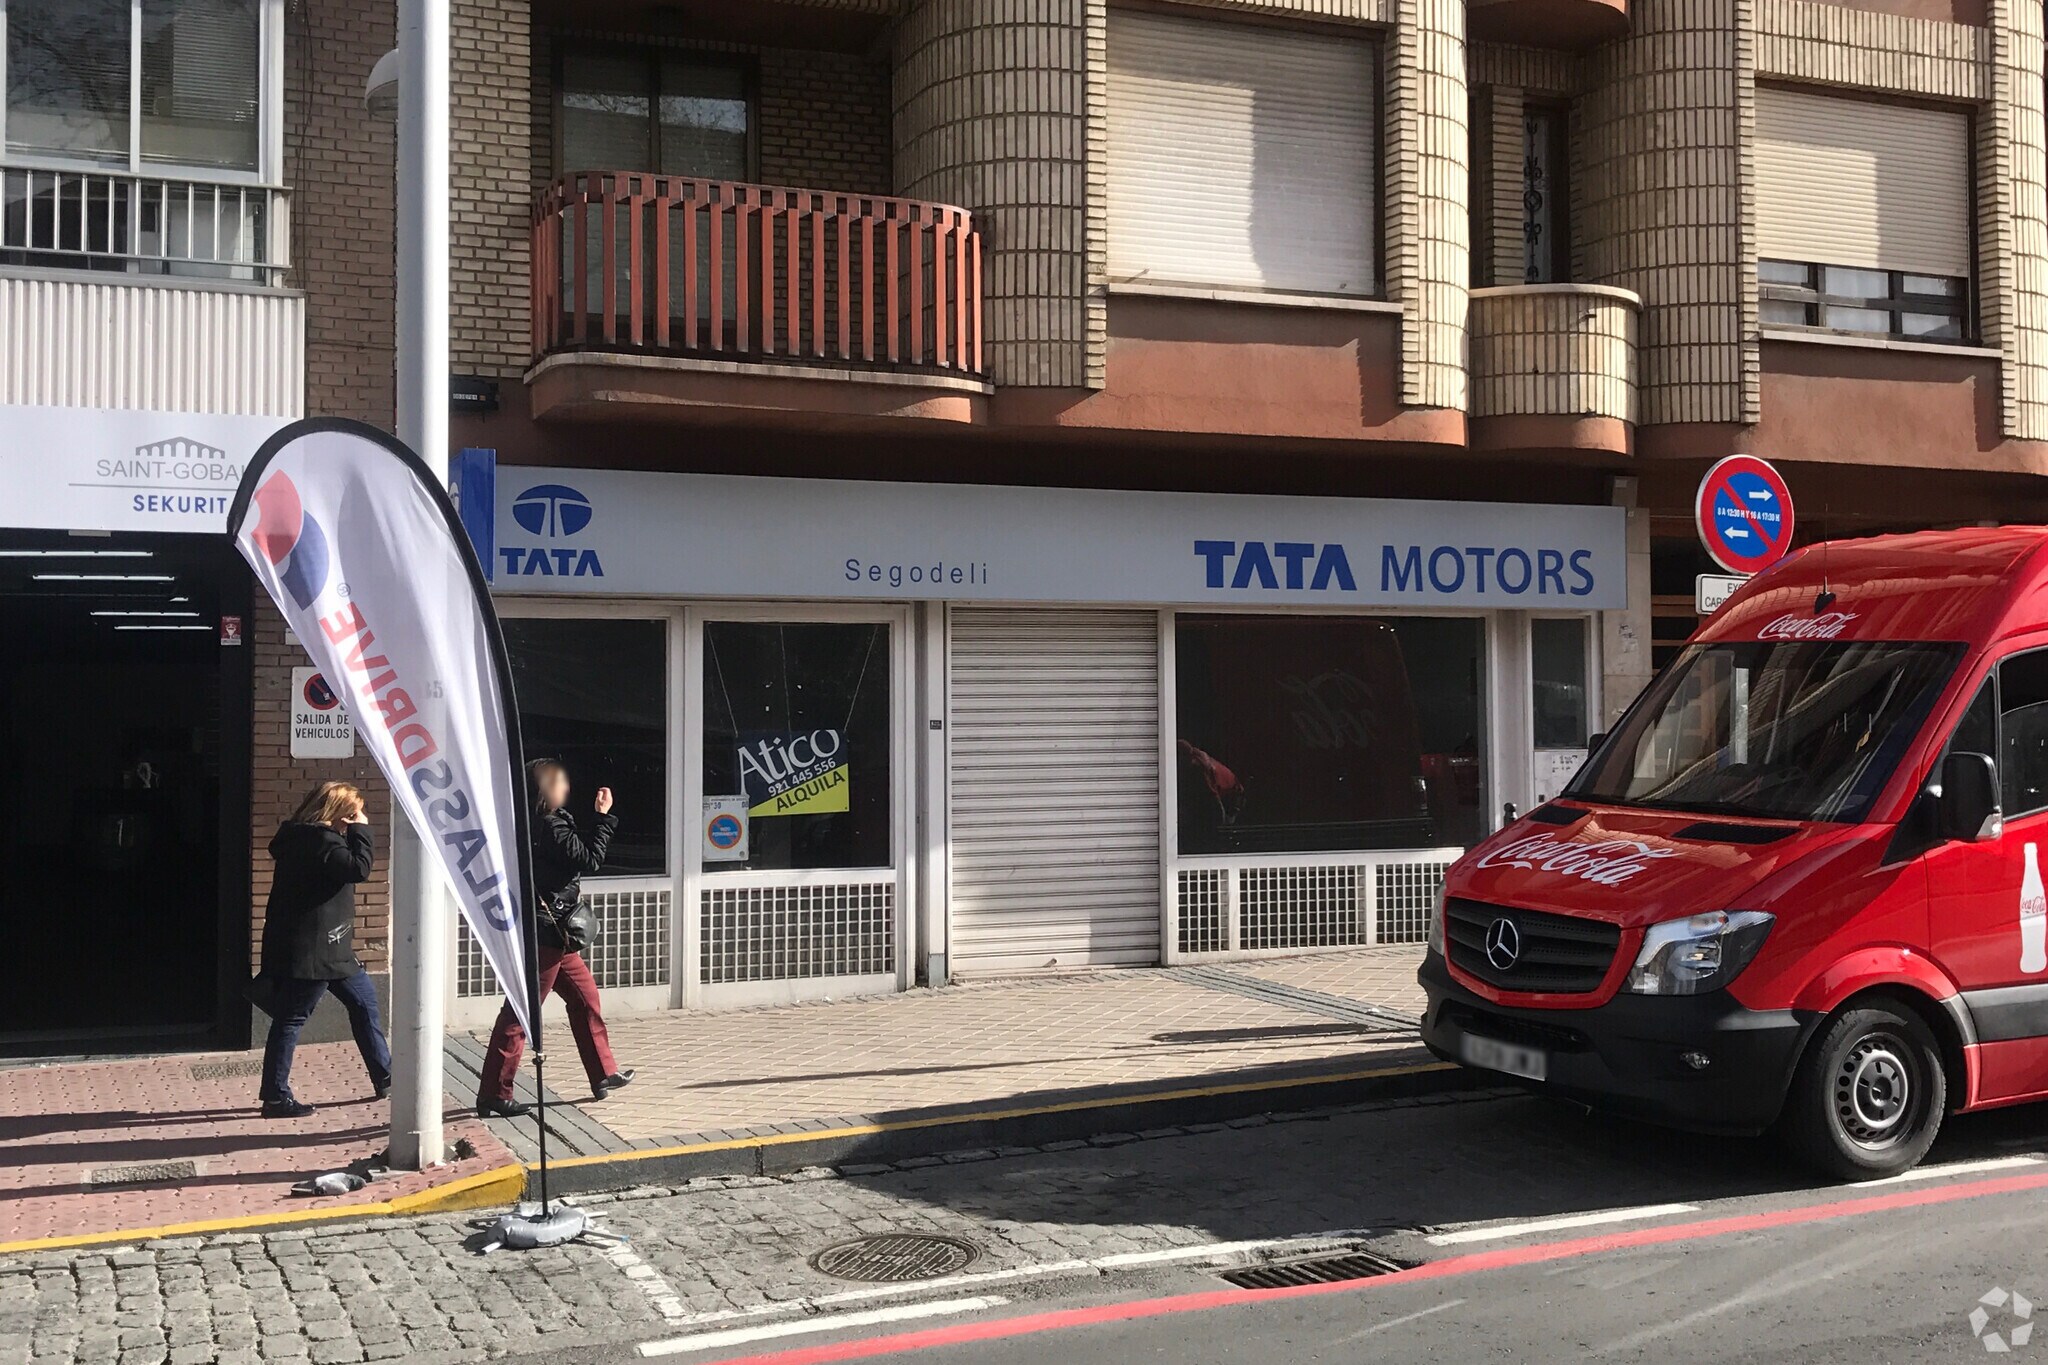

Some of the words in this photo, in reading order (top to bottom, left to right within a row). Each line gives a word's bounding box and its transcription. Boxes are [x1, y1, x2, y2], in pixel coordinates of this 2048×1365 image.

[133, 494, 227, 514] SEKURIT
[1740, 509, 1745, 519] H
[1745, 509, 1750, 519] Y
[1757, 510, 1762, 520] A
[1775, 513, 1781, 522] H
[500, 547, 604, 577] TATA
[845, 559, 987, 588] Segodeli
[1193, 540, 1358, 592] TATA
[1380, 544, 1596, 597] MOTORS
[295, 728, 350, 739] VEHICULOS
[296, 714, 331, 725] SALIDA
[337, 714, 349, 725] DE
[792, 768, 813, 785] 445
[814, 757, 836, 775] 556
[776, 770, 846, 813] ALQUILA
[1477, 832, 1686, 885] Coca-Cola
